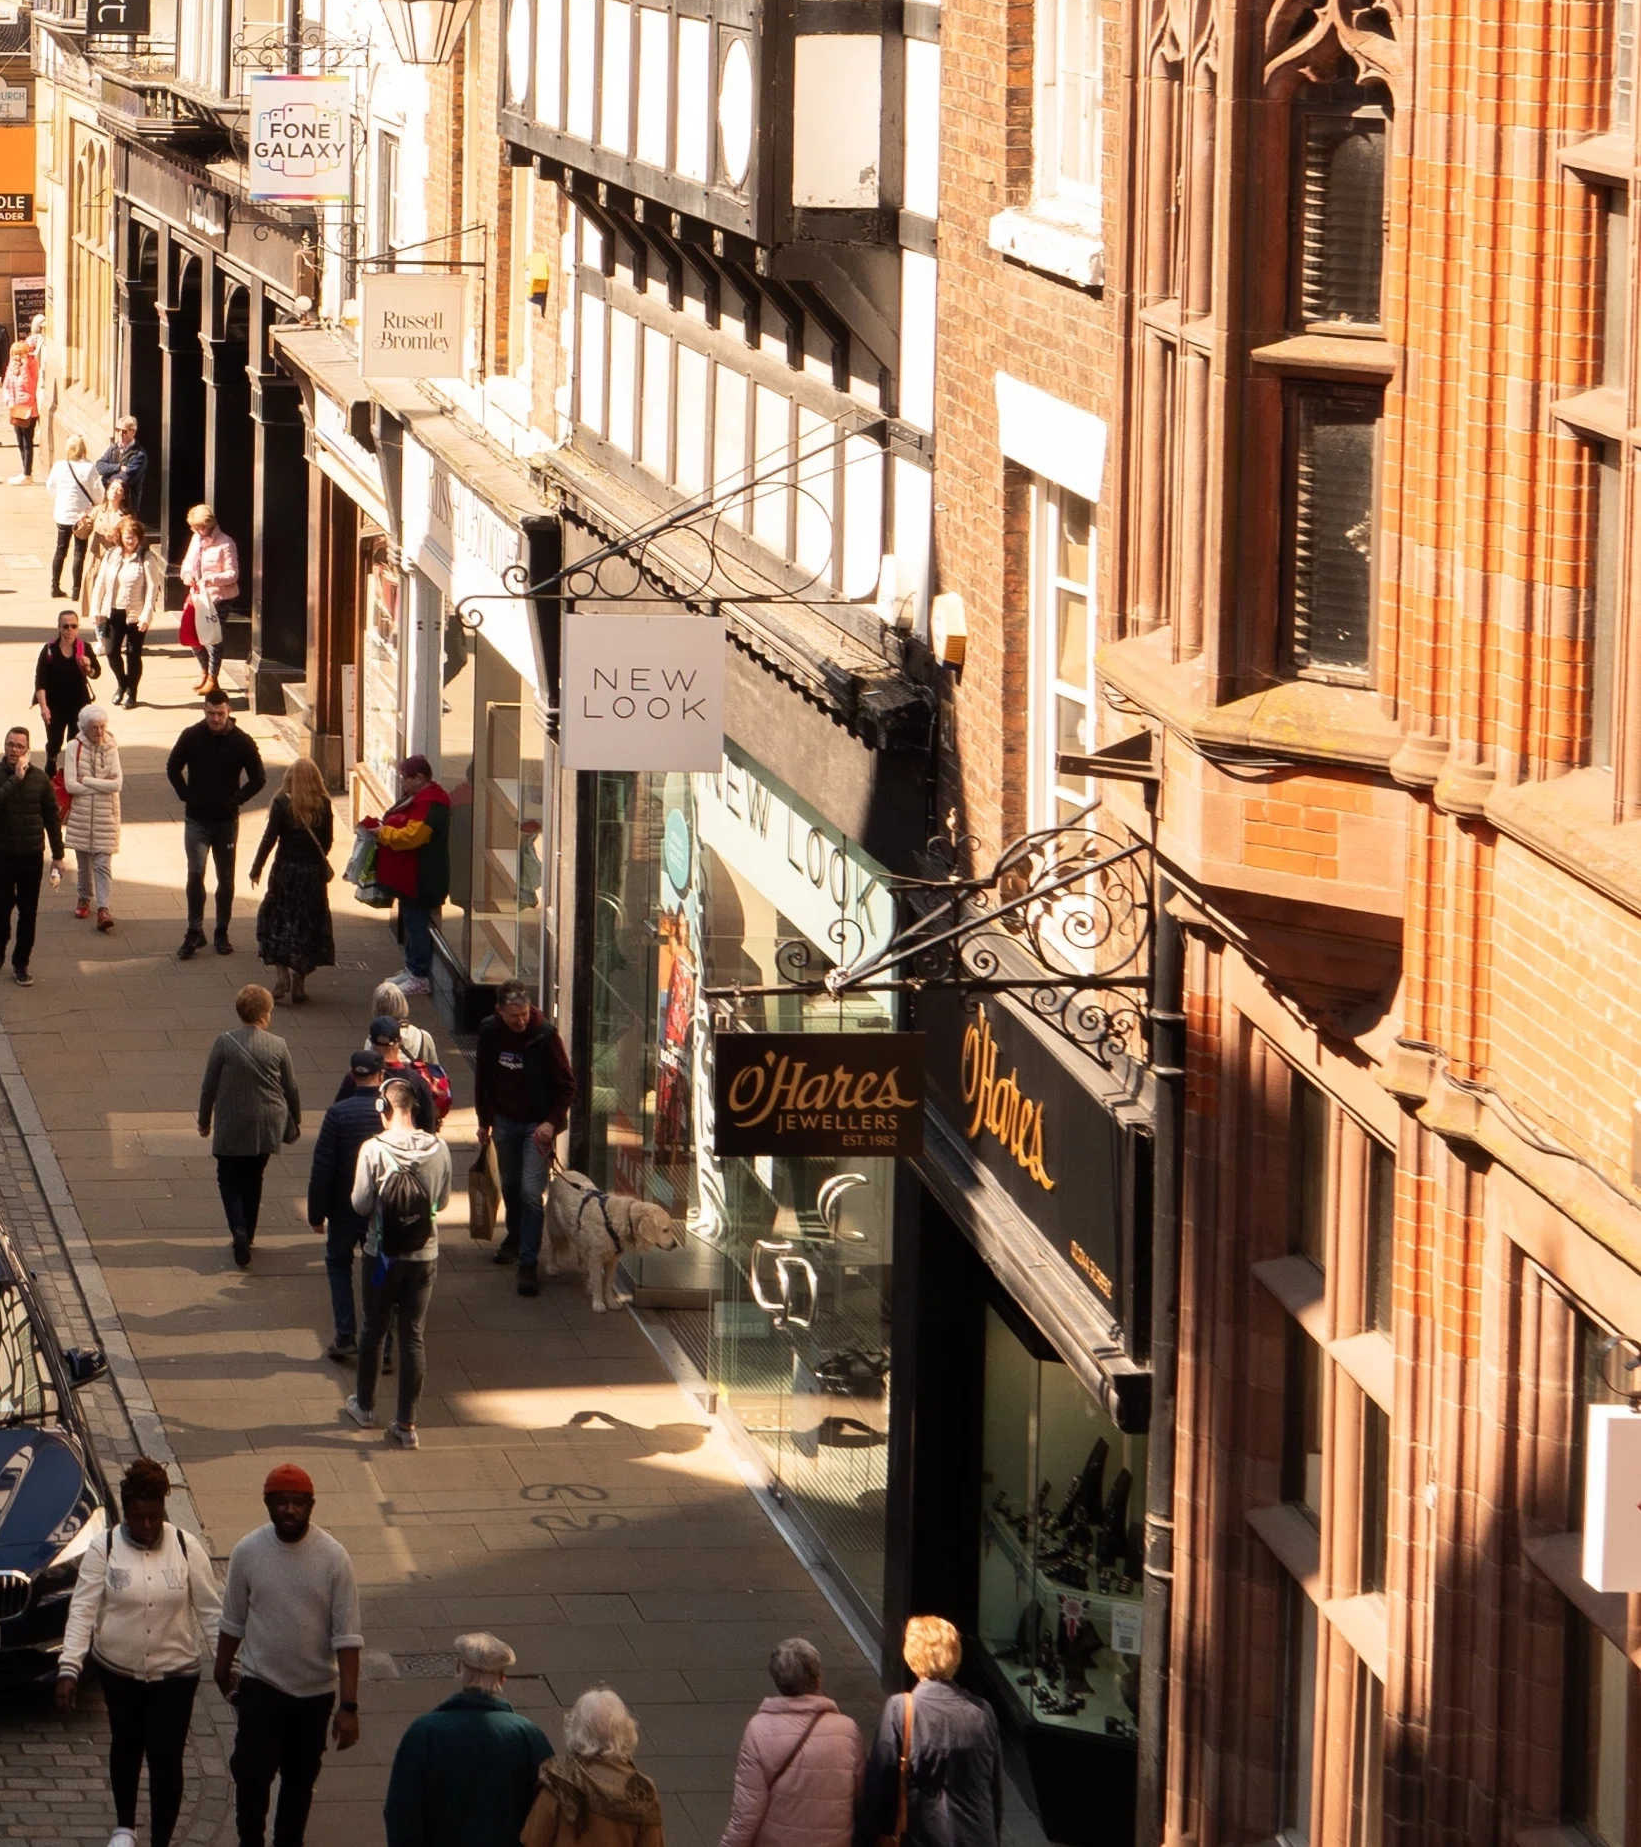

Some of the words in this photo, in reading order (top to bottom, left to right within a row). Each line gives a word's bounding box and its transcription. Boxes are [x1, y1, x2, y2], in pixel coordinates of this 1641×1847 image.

[270, 123, 330, 139] FONE
[254, 142, 346, 159] GALAXY
[383, 310, 443, 330] Russell
[593, 667, 697, 692] NEW
[582, 695, 707, 722] LOOK
[787, 805, 878, 940] LOOK
[728, 1050, 918, 1128] O'Hares
[961, 1001, 1057, 1194] O'Hares
[775, 1114, 899, 1134] JEWELLERS
[842, 1134, 866, 1147] EST.
[869, 1134, 898, 1146] 1982
